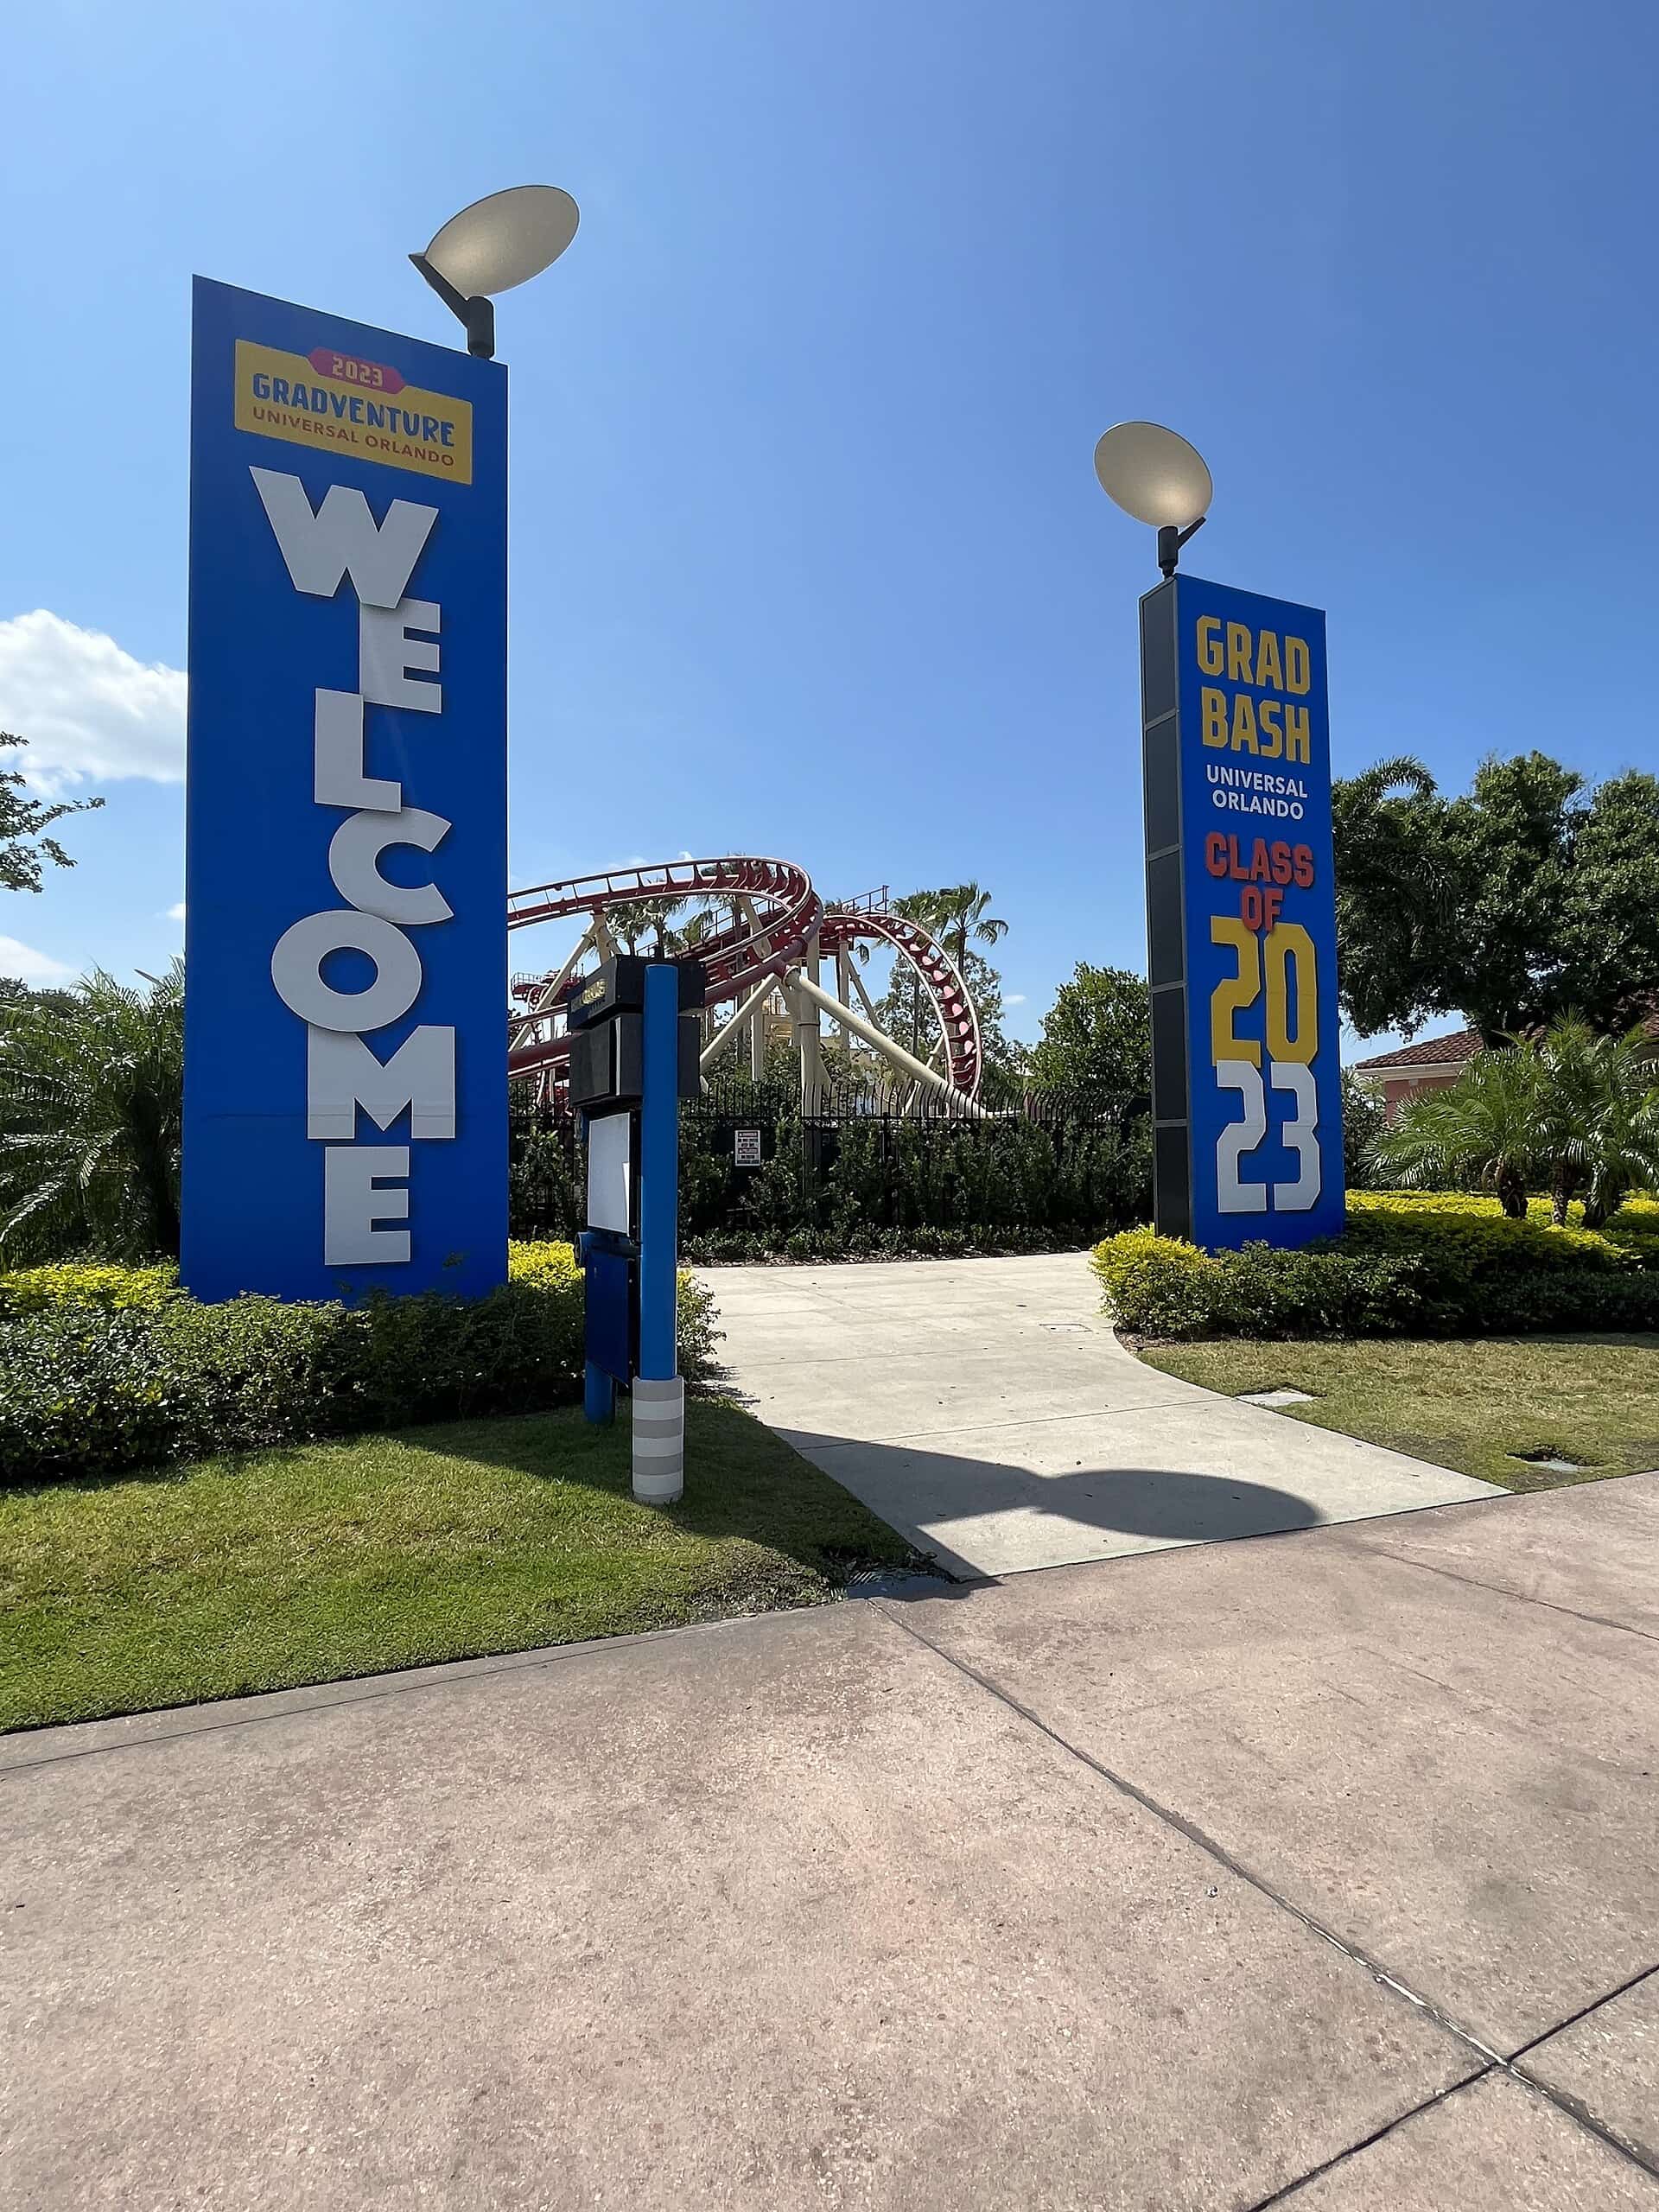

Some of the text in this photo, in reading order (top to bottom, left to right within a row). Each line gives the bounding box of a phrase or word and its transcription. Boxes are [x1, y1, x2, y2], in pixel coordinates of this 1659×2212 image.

[332, 355, 383, 387] 2023
[252, 373, 454, 447] GRADVENTURE
[253, 406, 454, 467] UNIVERSAL ORLANDO
[1196, 615, 1311, 695] GRAD
[1201, 686, 1310, 764] BASH
[1206, 765, 1308, 798] UNIVERSAL
[1212, 790, 1304, 820] ORLANDO
[249, 466, 455, 1265] WELCOME
[1205, 831, 1314, 888] CLASS
[1241, 884, 1283, 932] OF
